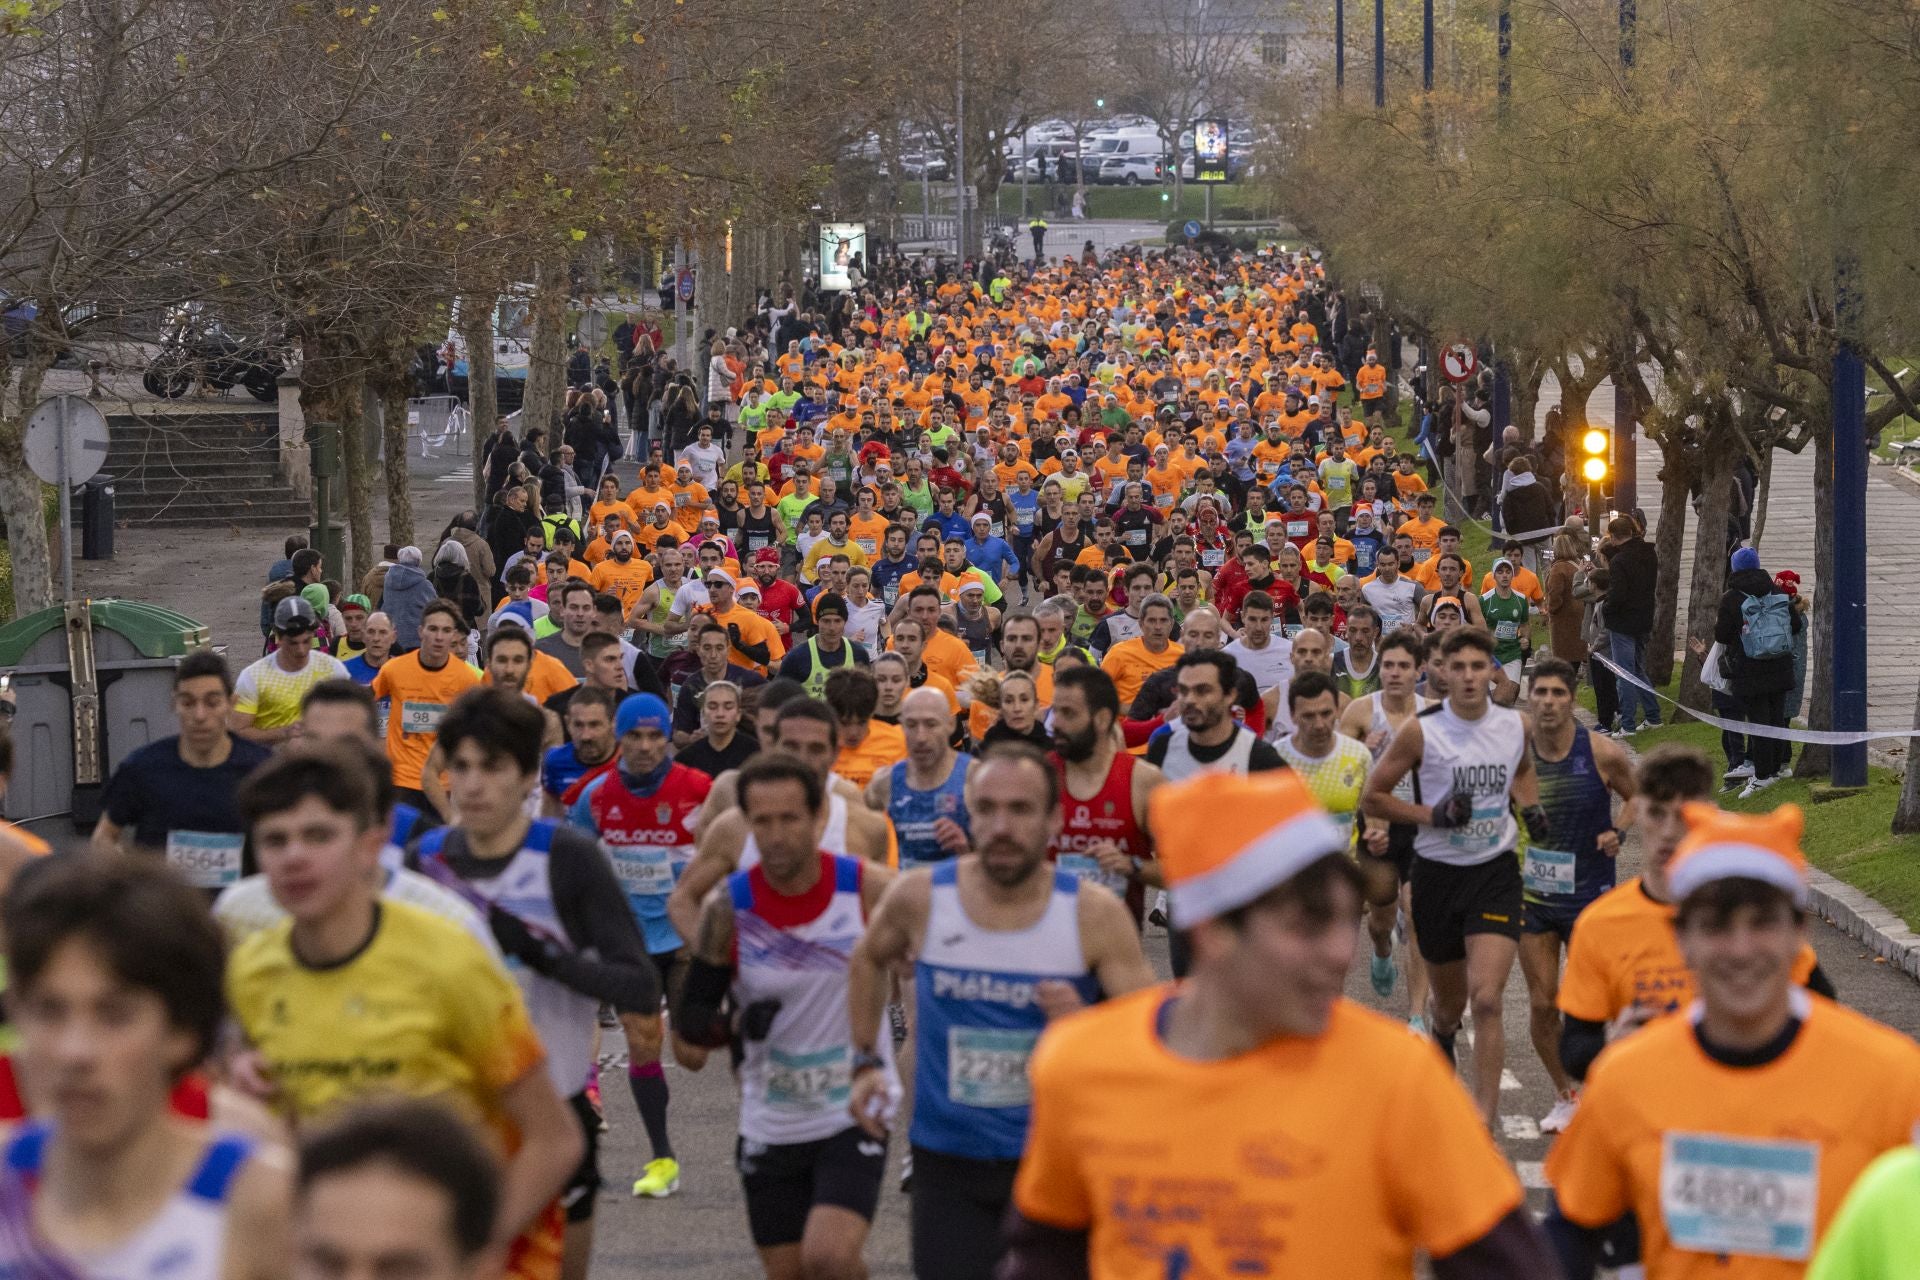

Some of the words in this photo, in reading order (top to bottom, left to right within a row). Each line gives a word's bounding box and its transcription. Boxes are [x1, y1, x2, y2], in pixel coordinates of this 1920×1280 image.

[413, 712, 429, 723] 98
[1452, 763, 1508, 791] WOODS
[1531, 862, 1557, 879] 304
[933, 970, 1034, 1009] Piélag
